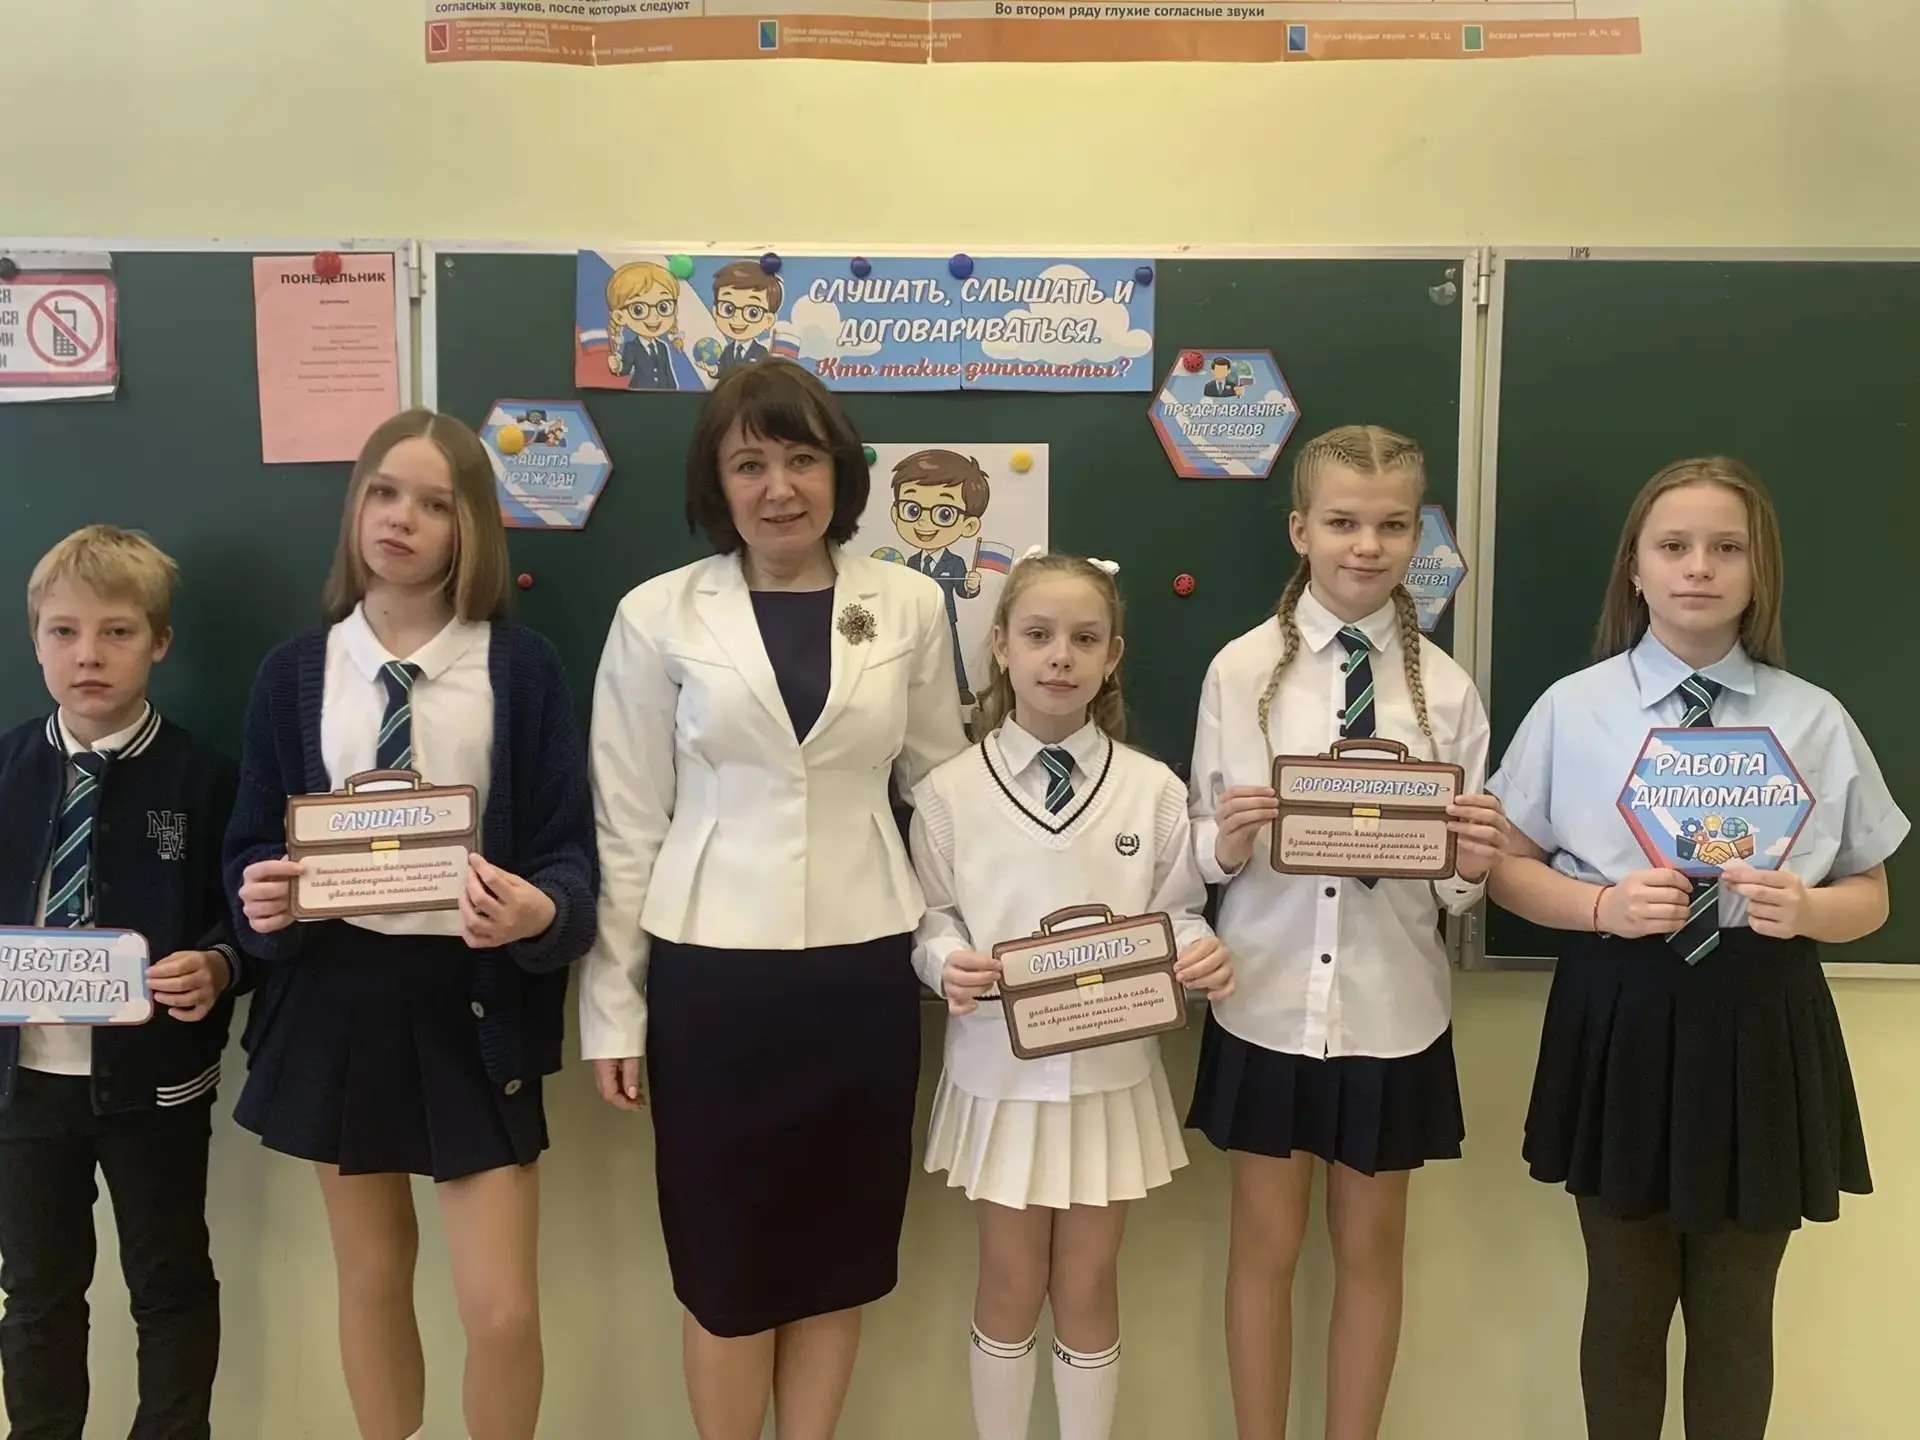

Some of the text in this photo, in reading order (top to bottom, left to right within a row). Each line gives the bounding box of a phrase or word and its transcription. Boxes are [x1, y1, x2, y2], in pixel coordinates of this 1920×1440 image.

[435, 1, 690, 16] согласных звуков, после которых следуют
[995, 2, 1265, 19] Во втором ряду глухие согласные звуки
[280, 273, 386, 285] ПОНЕДЕЛЬНИК
[809, 278, 1134, 306] СЛУШАТЬ, СЛЫШАТЬ И
[0, 310, 19, 326] СЯ
[837, 317, 1102, 347] ДОГОВАРИВАТЬСЯ.
[814, 356, 1133, 381] Кто такие дипломаты?
[1163, 403, 1286, 419] ПРЕДСТАВЛЕНИЕ
[1181, 422, 1265, 436] ИНТЕРЕСОВ
[1654, 751, 1768, 777] РАБОТА
[1290, 776, 1439, 796] ДОГОВАРИВАТЬСЯ
[1631, 784, 1799, 810] ДИПЛОМАТА
[328, 806, 435, 832] СЛУШАТЬ
[1305, 829, 1353, 838] находить
[1354, 829, 1418, 840] компромиссы
[1379, 843, 1421, 851] решения
[1422, 843, 1439, 852] для
[310, 877, 339, 887] слова
[0, 946, 110, 973] ЧЕСТВА
[1029, 937, 1135, 975] СЛЫШАТЬ
